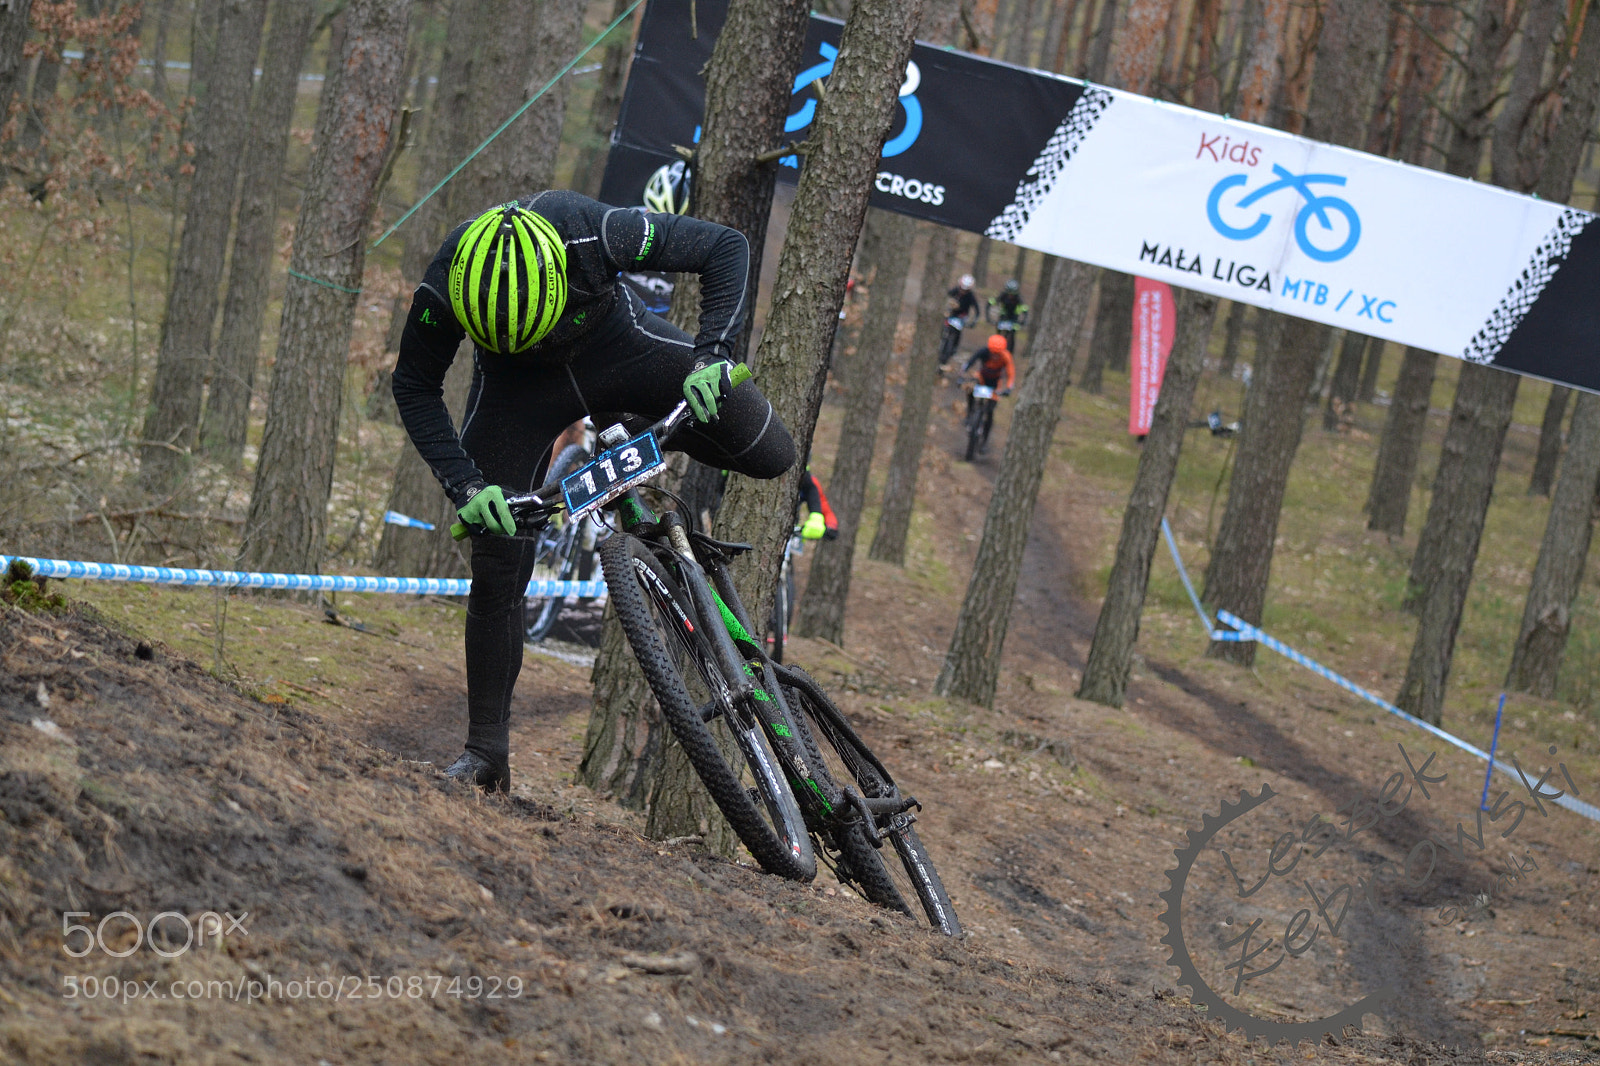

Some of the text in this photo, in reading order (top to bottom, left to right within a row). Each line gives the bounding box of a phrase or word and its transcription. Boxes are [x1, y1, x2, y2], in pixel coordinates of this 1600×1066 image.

[1195, 132, 1262, 167] Kids
[875, 171, 946, 206] CROSS
[548, 262, 556, 291] GIRO
[1139, 240, 1202, 276] MAŁA
[1212, 257, 1272, 293] LIGA
[1281, 275, 1329, 306] MTB
[1356, 294, 1397, 323] XC
[579, 447, 643, 496] 113
